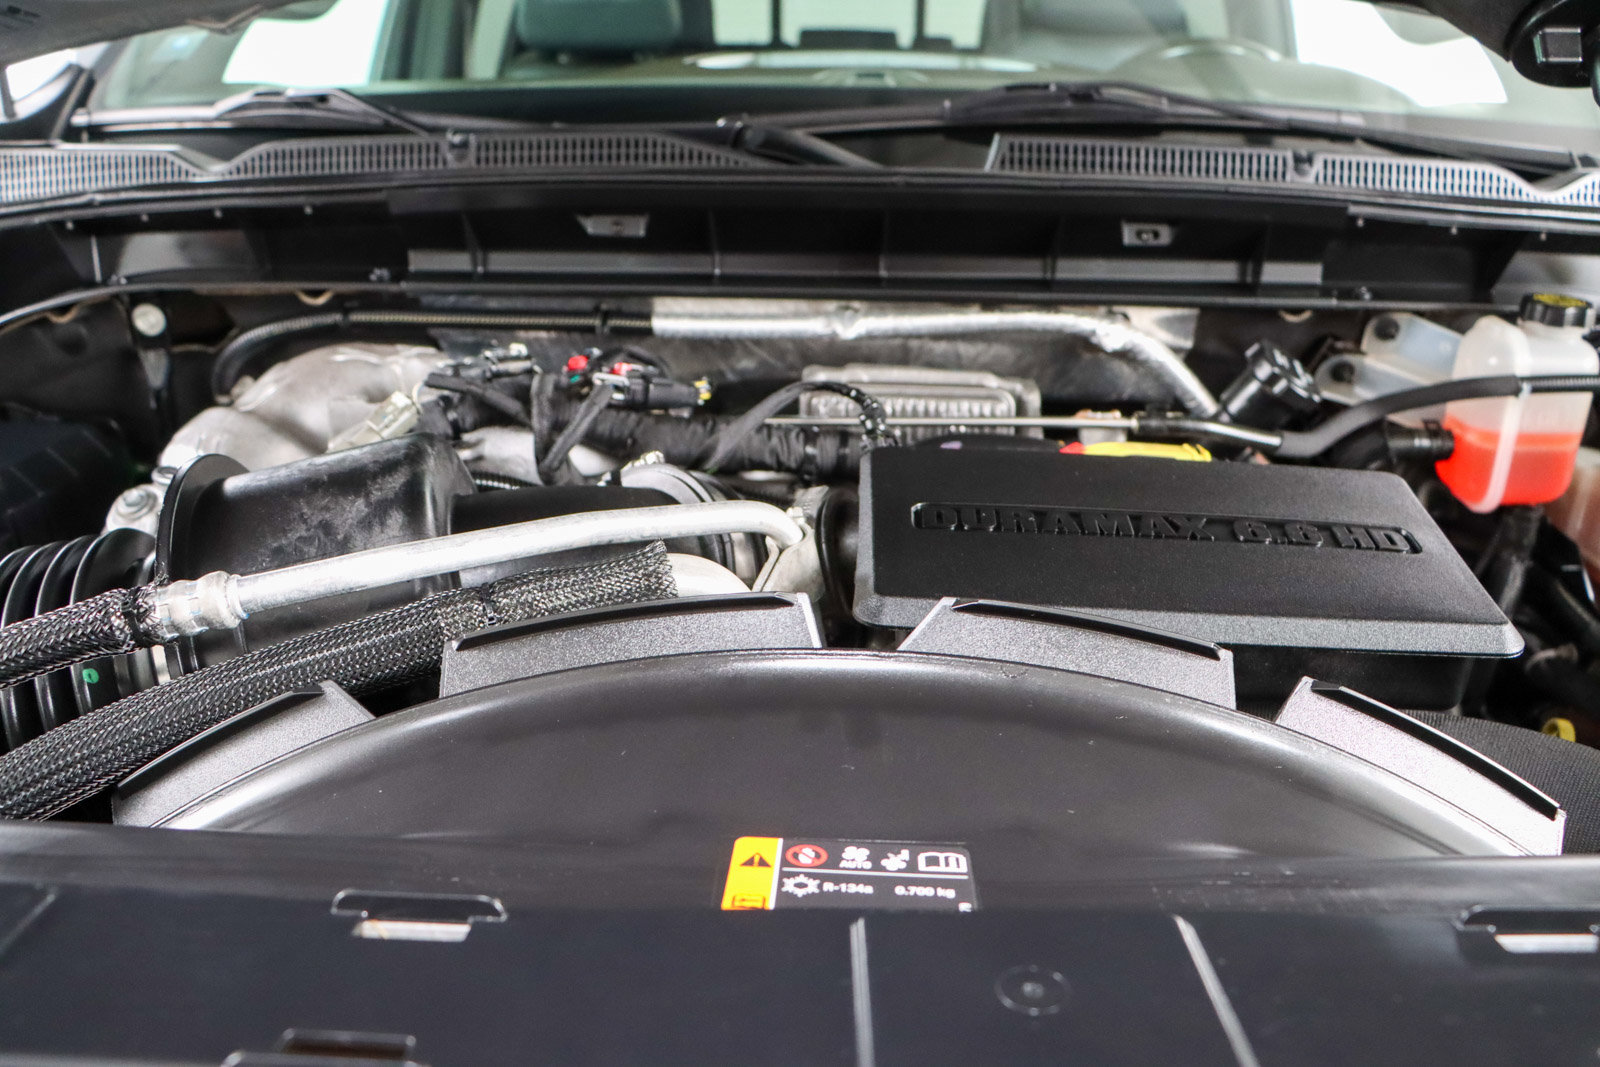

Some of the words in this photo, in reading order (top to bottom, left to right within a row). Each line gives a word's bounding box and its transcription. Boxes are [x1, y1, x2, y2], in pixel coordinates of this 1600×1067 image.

[921, 506, 1215, 541] DURAMAX
[1233, 519, 1323, 547] 6.6
[1334, 525, 1411, 553] HD
[839, 860, 872, 870] AUTO
[822, 882, 874, 894] R-134a
[937, 887, 956, 899] kg
